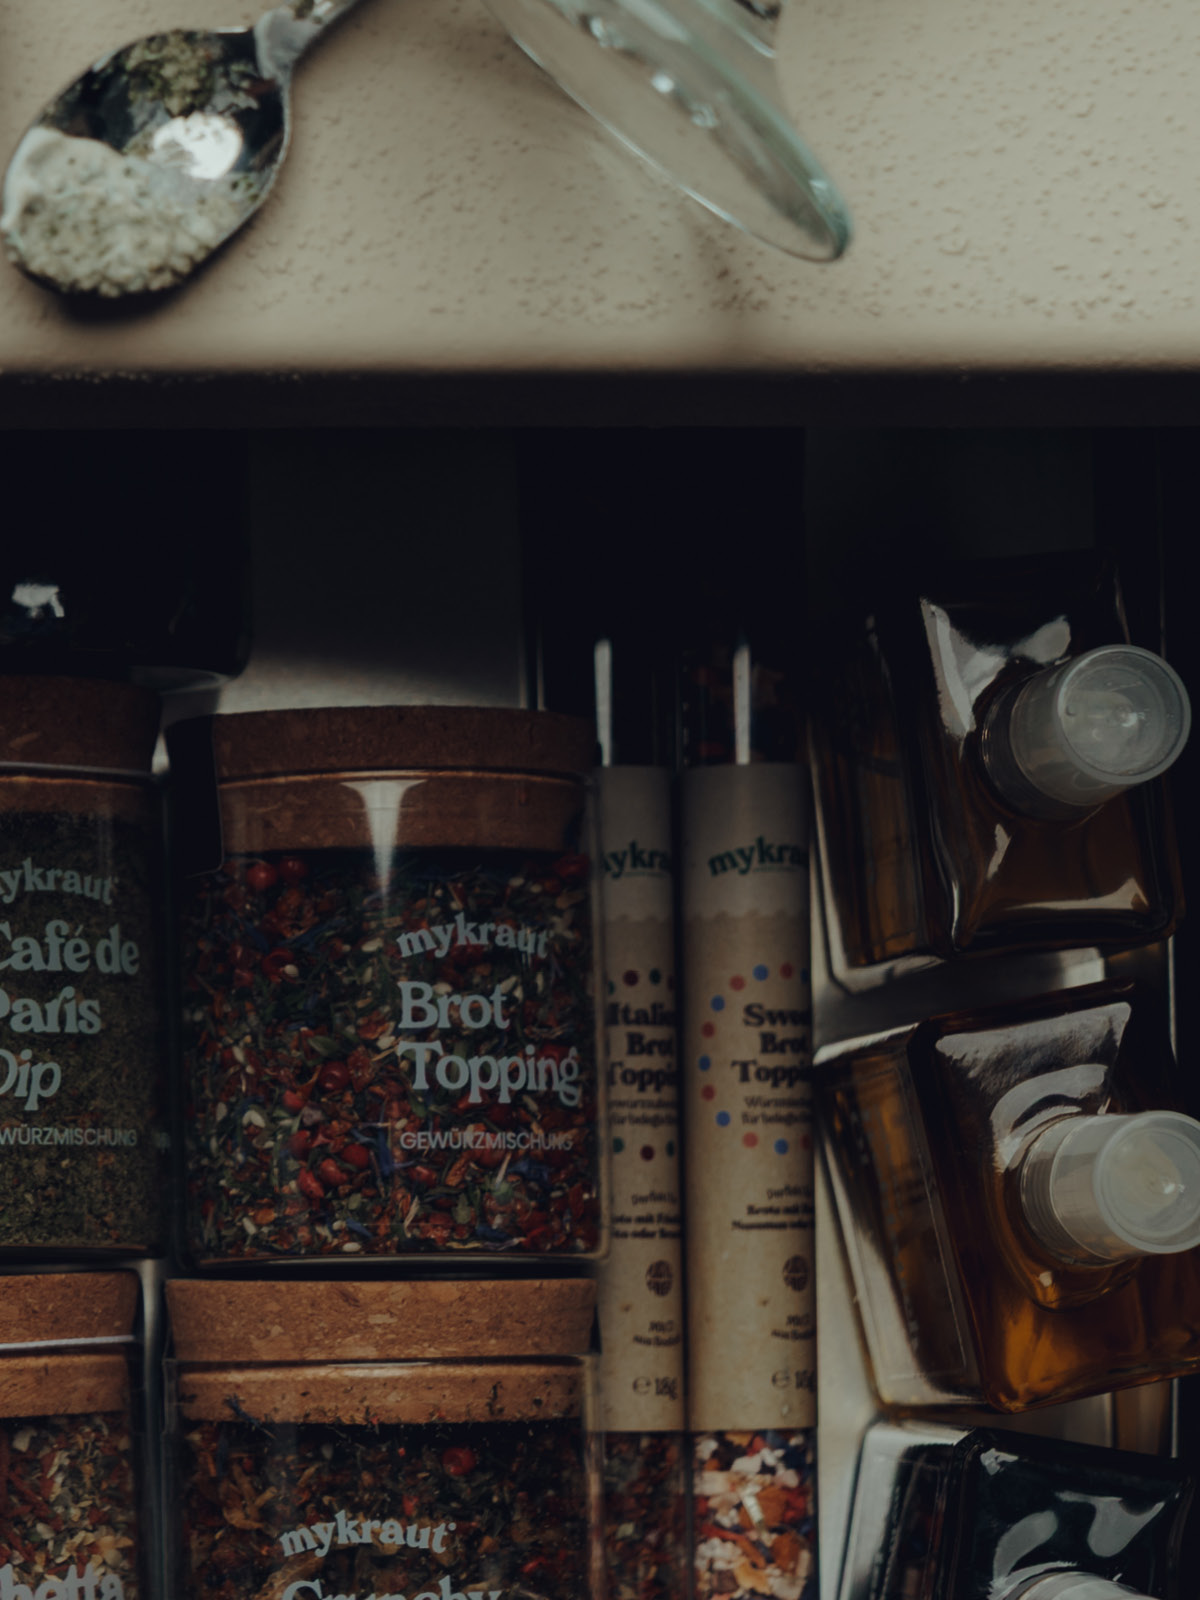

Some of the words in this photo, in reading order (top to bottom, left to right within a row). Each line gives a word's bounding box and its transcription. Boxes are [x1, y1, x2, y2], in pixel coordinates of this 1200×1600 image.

[95, 922, 141, 976] de
[396, 911, 548, 960] mykraut
[398, 981, 510, 1030] Brot
[397, 1041, 580, 1107] Topping
[399, 1129, 574, 1152] GEWÜRZMISCHUNG
[279, 1509, 448, 1558] mykraut
